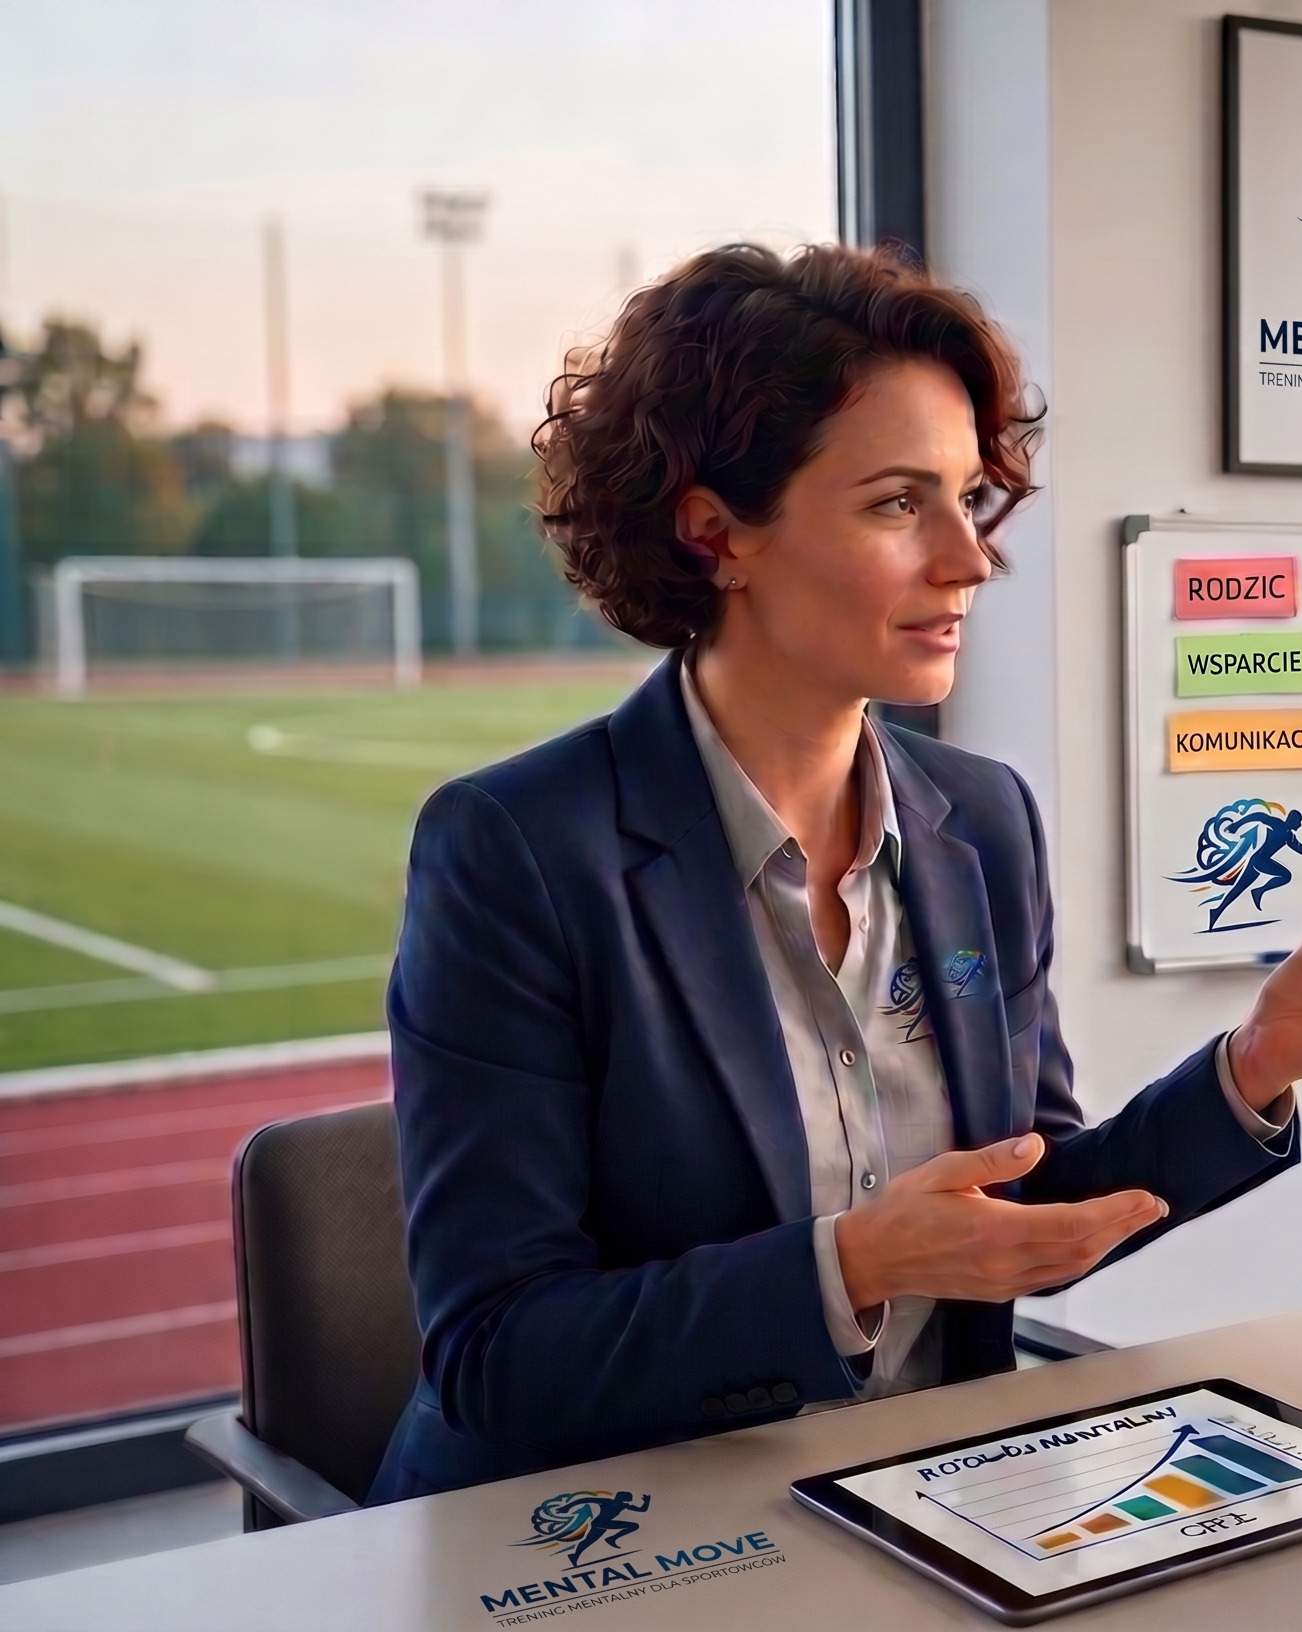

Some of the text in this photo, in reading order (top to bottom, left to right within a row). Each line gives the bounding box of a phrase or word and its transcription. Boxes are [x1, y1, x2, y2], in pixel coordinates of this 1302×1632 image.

[1187, 574, 1287, 602] RODZIC
[1187, 650, 1302, 676] WSPARCIE
[479, 1531, 776, 1613] MENTAL MOVE
[496, 1605, 566, 1628] TRENING
[567, 1586, 648, 1612] MENTALNY
[650, 1579, 681, 1593] DLA
